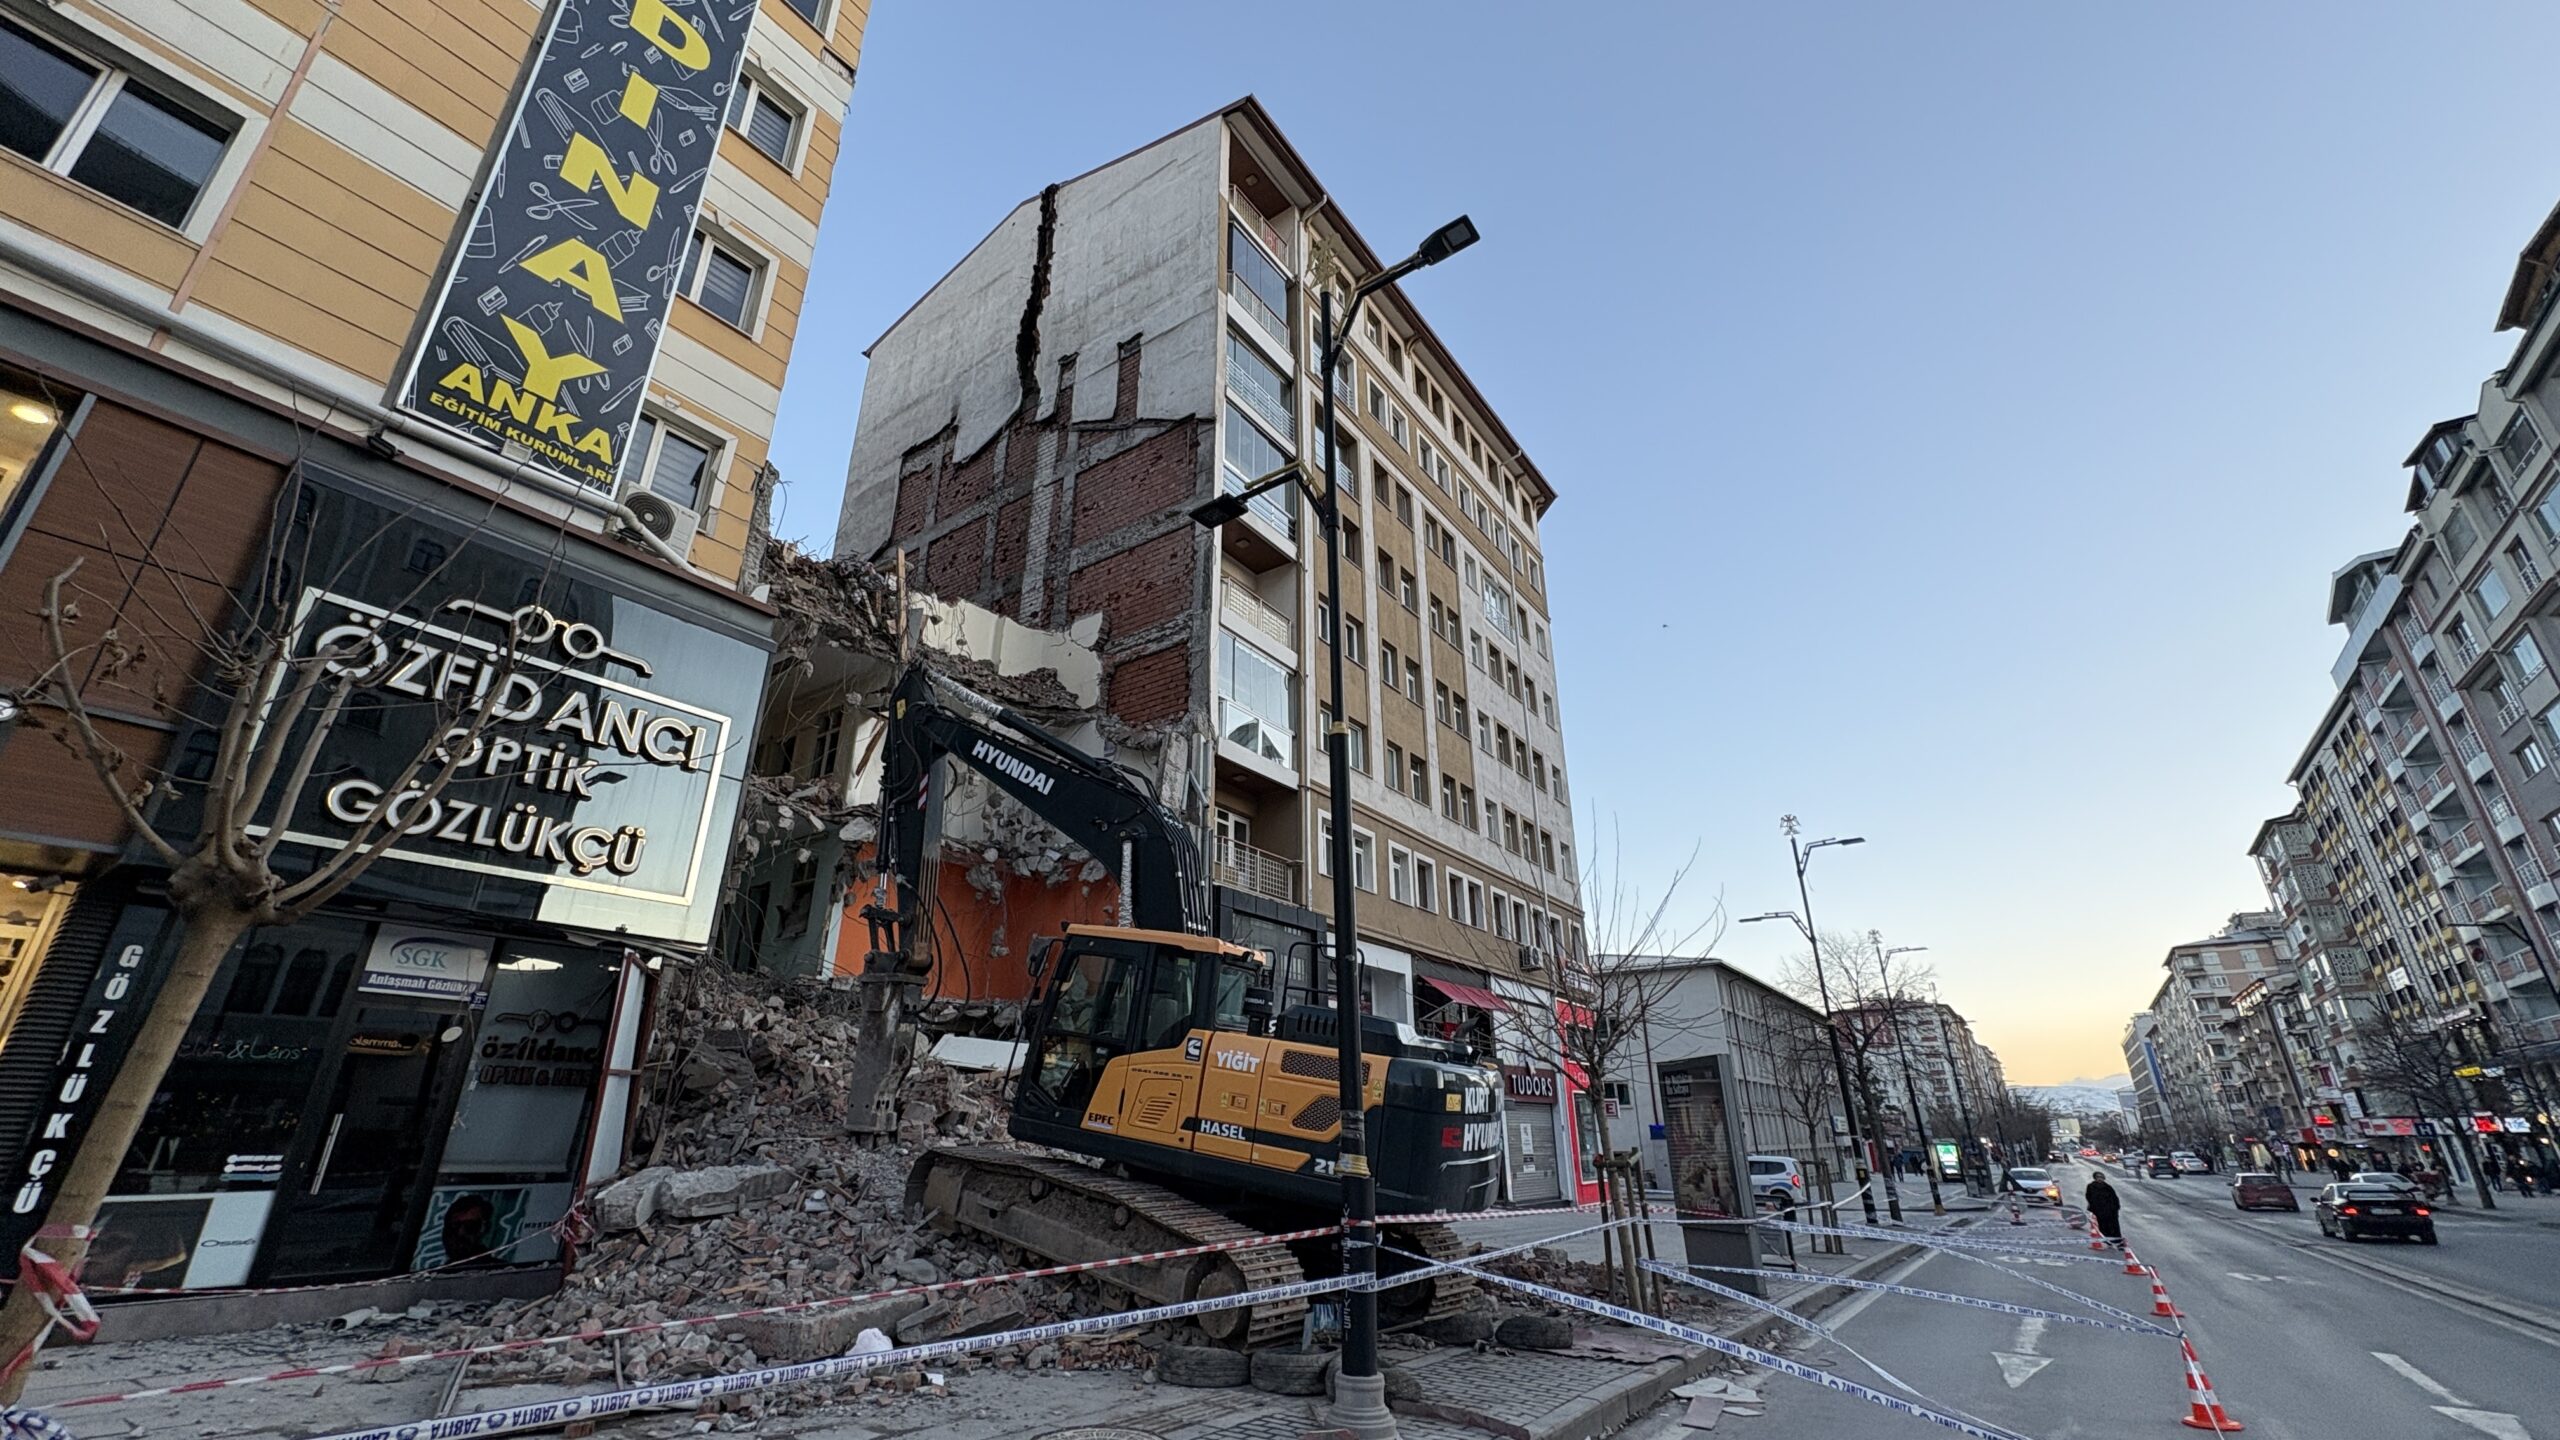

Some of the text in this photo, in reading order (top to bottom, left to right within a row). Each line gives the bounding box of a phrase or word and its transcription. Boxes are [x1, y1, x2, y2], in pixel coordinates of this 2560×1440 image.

[438, 362, 614, 467] ANKA
[429, 391, 613, 484] EĞİTİM KURUMLARI
[435, 727, 600, 800] OPTİK
[972, 739, 1055, 796] HYUNDAI
[327, 779, 648, 873] GÖZLÜKÇÜ
[396, 947, 448, 969] SGK
[368, 973, 427, 989] Anlaşmalı
[1216, 1050, 1261, 1074] YİĞİT
[13, 944, 144, 1214] GÖZLÜKÇÜ
[1511, 1074, 1553, 1097] TUDORS
[1465, 1087, 1490, 1115] KURT
[1605, 1103, 1615, 1115] E
[1088, 1112, 1115, 1126] EPFC
[1200, 1120, 1246, 1140] HASEL
[1541, 1289, 1561, 1302] ZABITA
[1574, 1297, 1594, 1310] ZABITA
[1609, 1308, 1631, 1321] ZABITA
[1643, 1317, 1666, 1331] ZABITA
[1681, 1328, 1705, 1343] ZABITA
[1718, 1339, 1742, 1355] ZABITA
[1758, 1353, 1783, 1369] ZABITA
[1797, 1366, 1823, 1384] ZABITA
[1842, 1382, 1868, 1400] ZABITA
[1885, 1398, 1912, 1415] ZABITA
[722, 1373, 757, 1393] ZABITA
[778, 1365, 811, 1383] ZABITA
[590, 1393, 633, 1413] ZABITA
[657, 1383, 696, 1404] ZABITA
[511, 1404, 559, 1427] ZABITA
[430, 1416, 482, 1440] ZABITA
